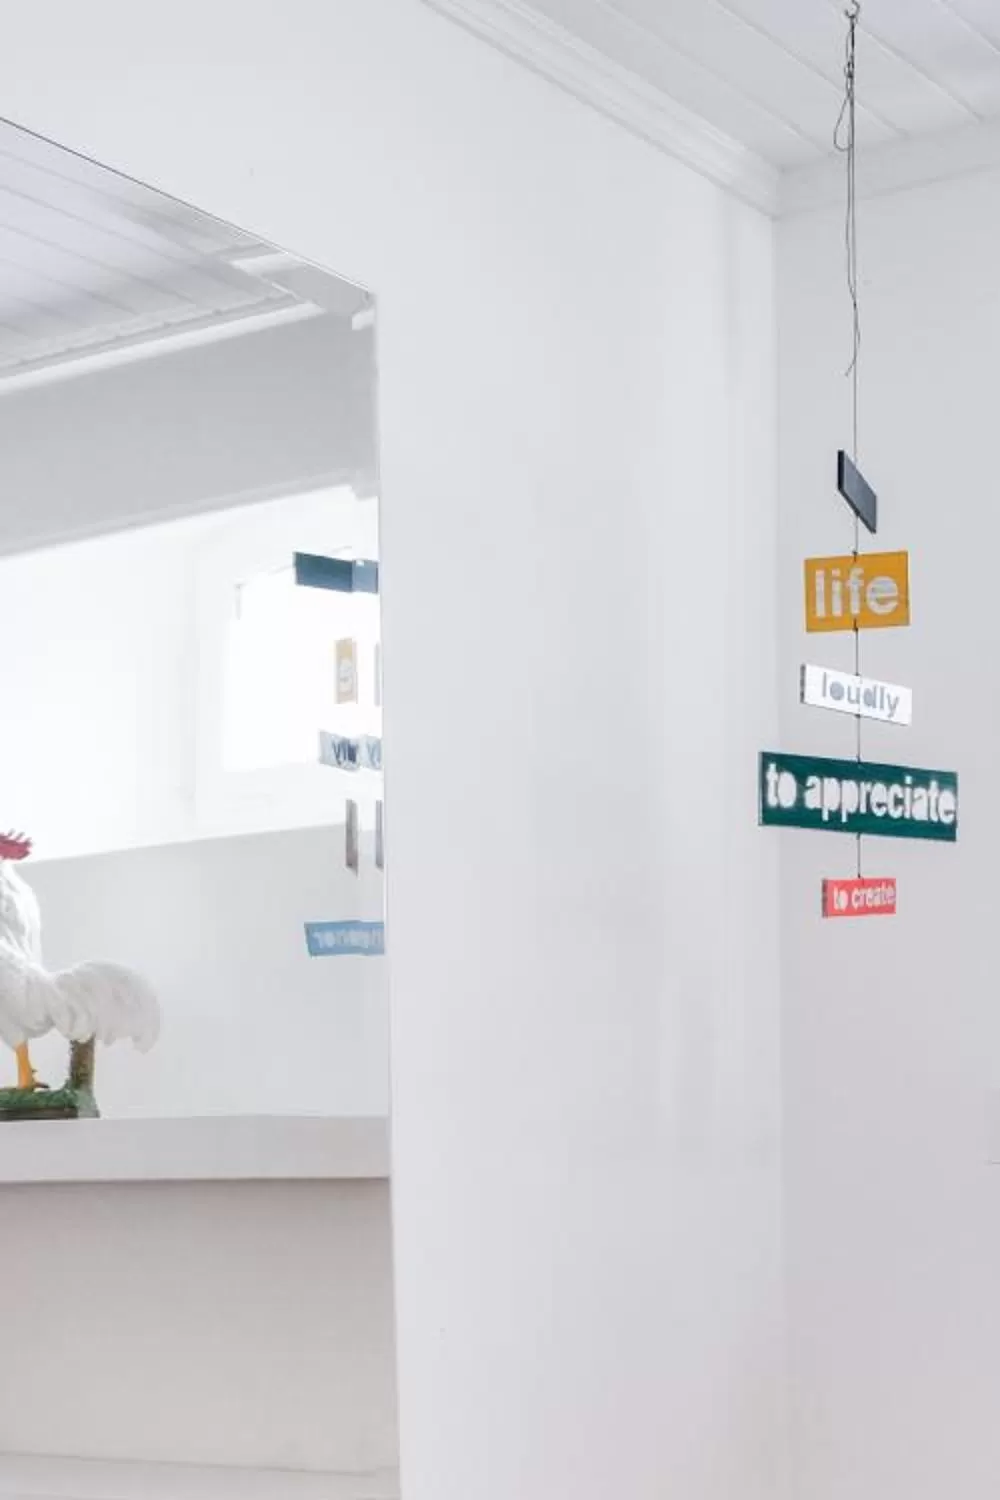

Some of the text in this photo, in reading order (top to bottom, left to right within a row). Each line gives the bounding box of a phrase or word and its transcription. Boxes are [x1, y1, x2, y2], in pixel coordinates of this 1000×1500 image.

[814, 566, 899, 618] life
[821, 671, 901, 718] loudly
[765, 762, 956, 825] to appreciate
[832, 883, 896, 910] to create
